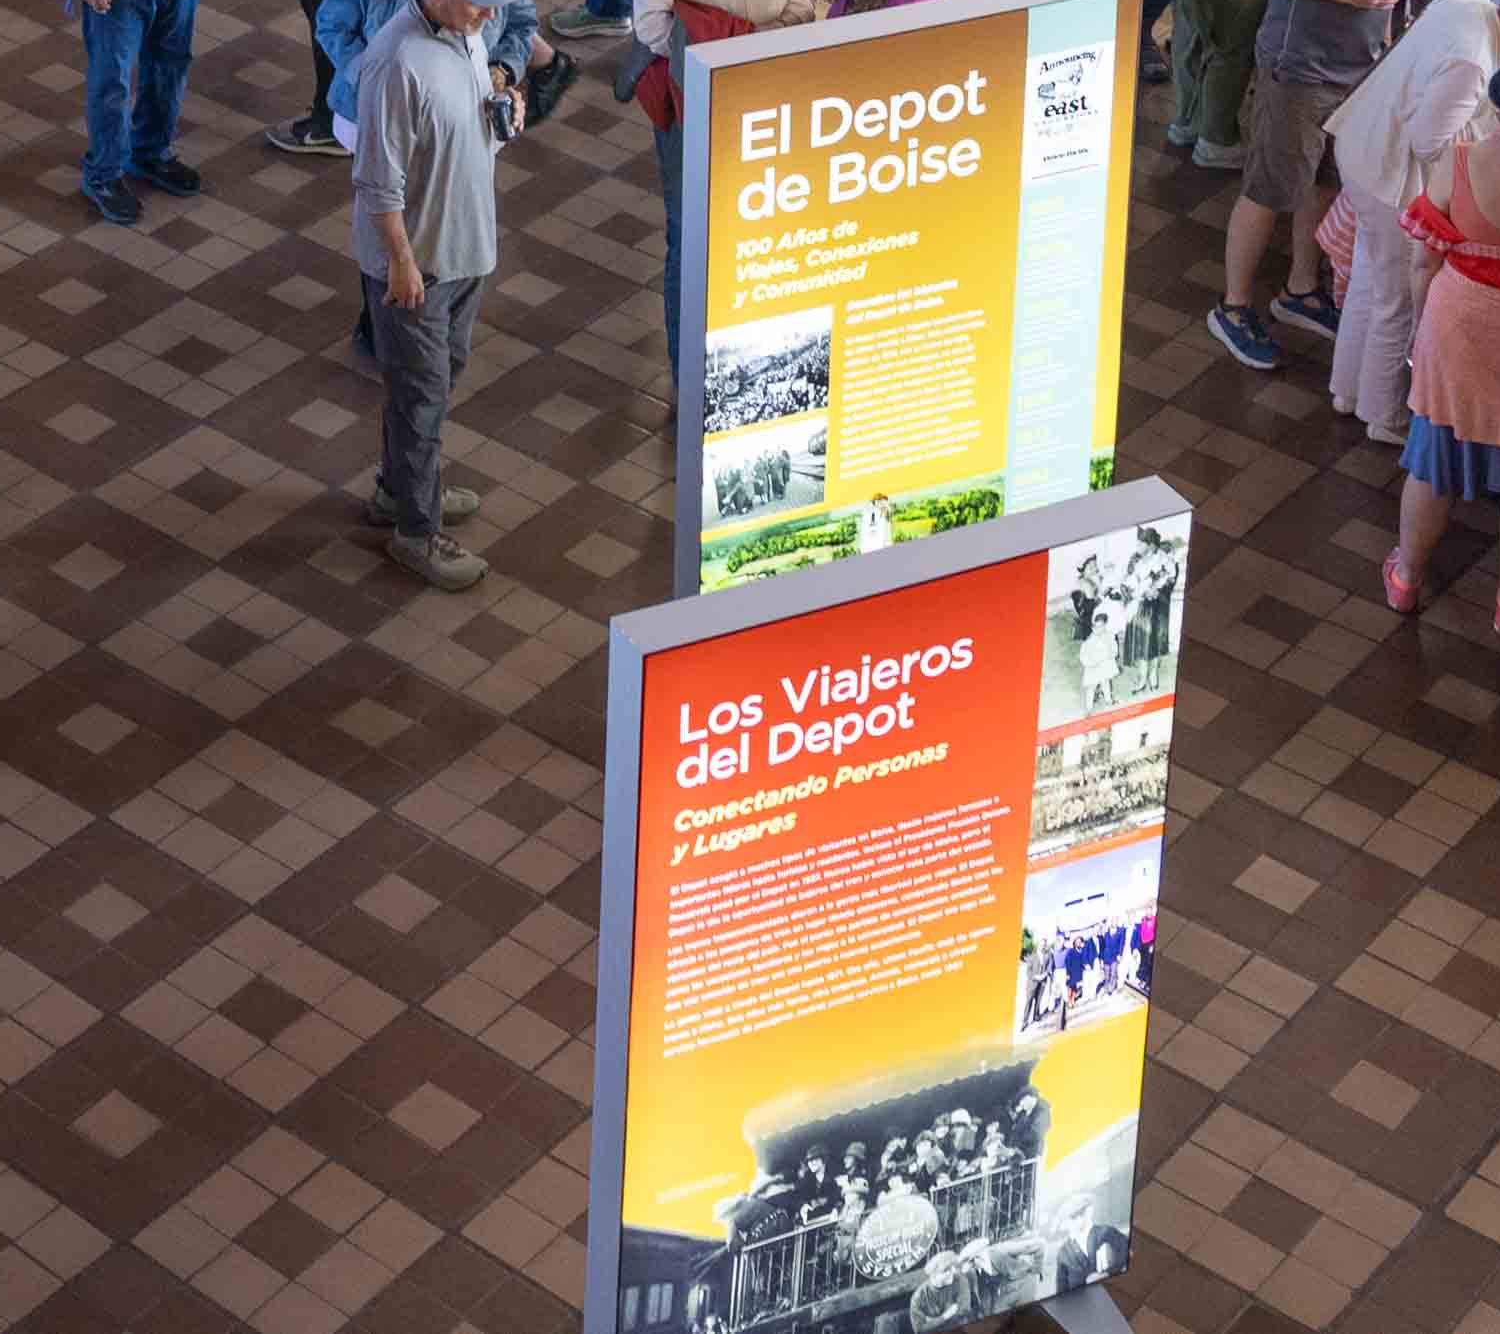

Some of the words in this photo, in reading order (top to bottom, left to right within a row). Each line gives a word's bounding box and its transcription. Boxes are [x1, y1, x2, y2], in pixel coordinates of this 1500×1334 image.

[742, 104, 791, 161] El
[811, 70, 987, 148] Depot
[1044, 95, 1088, 117] east
[738, 167, 810, 220] de
[829, 138, 981, 204] Boise
[736, 236, 773, 260] 100
[776, 228, 828, 252] Años
[832, 220, 858, 239] de
[736, 258, 799, 282] Viajes,
[805, 231, 919, 267] Conexiones
[733, 291, 748, 309] y
[752, 261, 867, 303] Comunidad
[680, 695, 763, 744] Los
[778, 638, 973, 714] Viajeros
[676, 732, 749, 788] del
[768, 692, 915, 765] Depot
[674, 775, 827, 833] Conectando
[833, 743, 949, 788] Personas
[670, 842, 689, 866] y
[693, 813, 796, 857] Lugares
